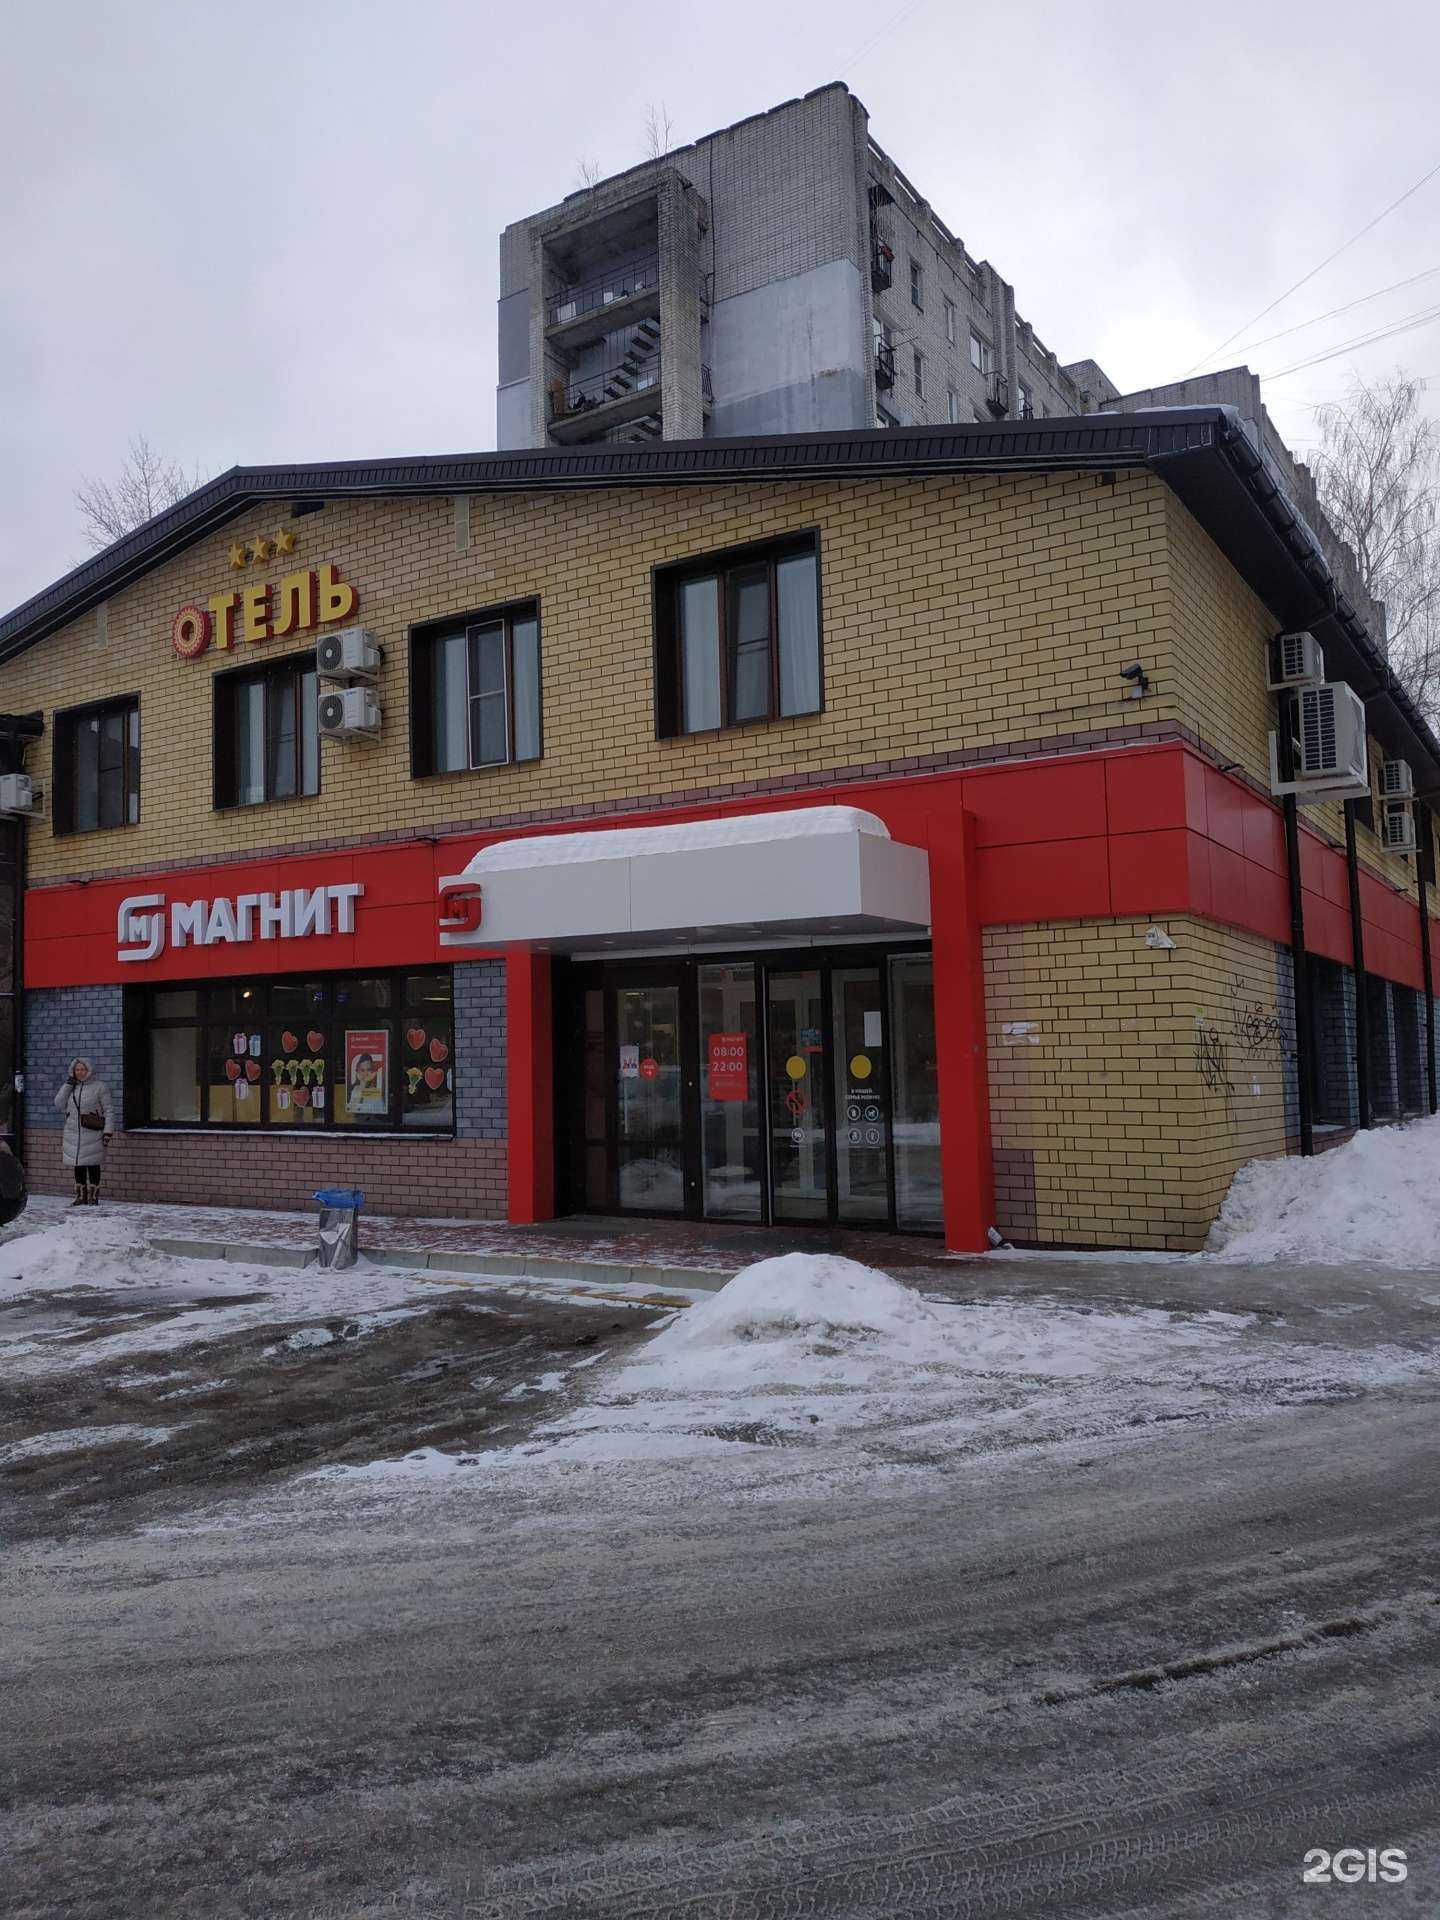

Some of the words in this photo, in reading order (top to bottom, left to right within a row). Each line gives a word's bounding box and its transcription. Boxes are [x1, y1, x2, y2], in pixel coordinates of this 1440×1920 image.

[172, 564, 359, 658] ОТЕЛЬ
[171, 883, 365, 947] МАГНИТ
[713, 1046, 744, 1057] 08:00
[713, 1062, 743, 1072] 22:00
